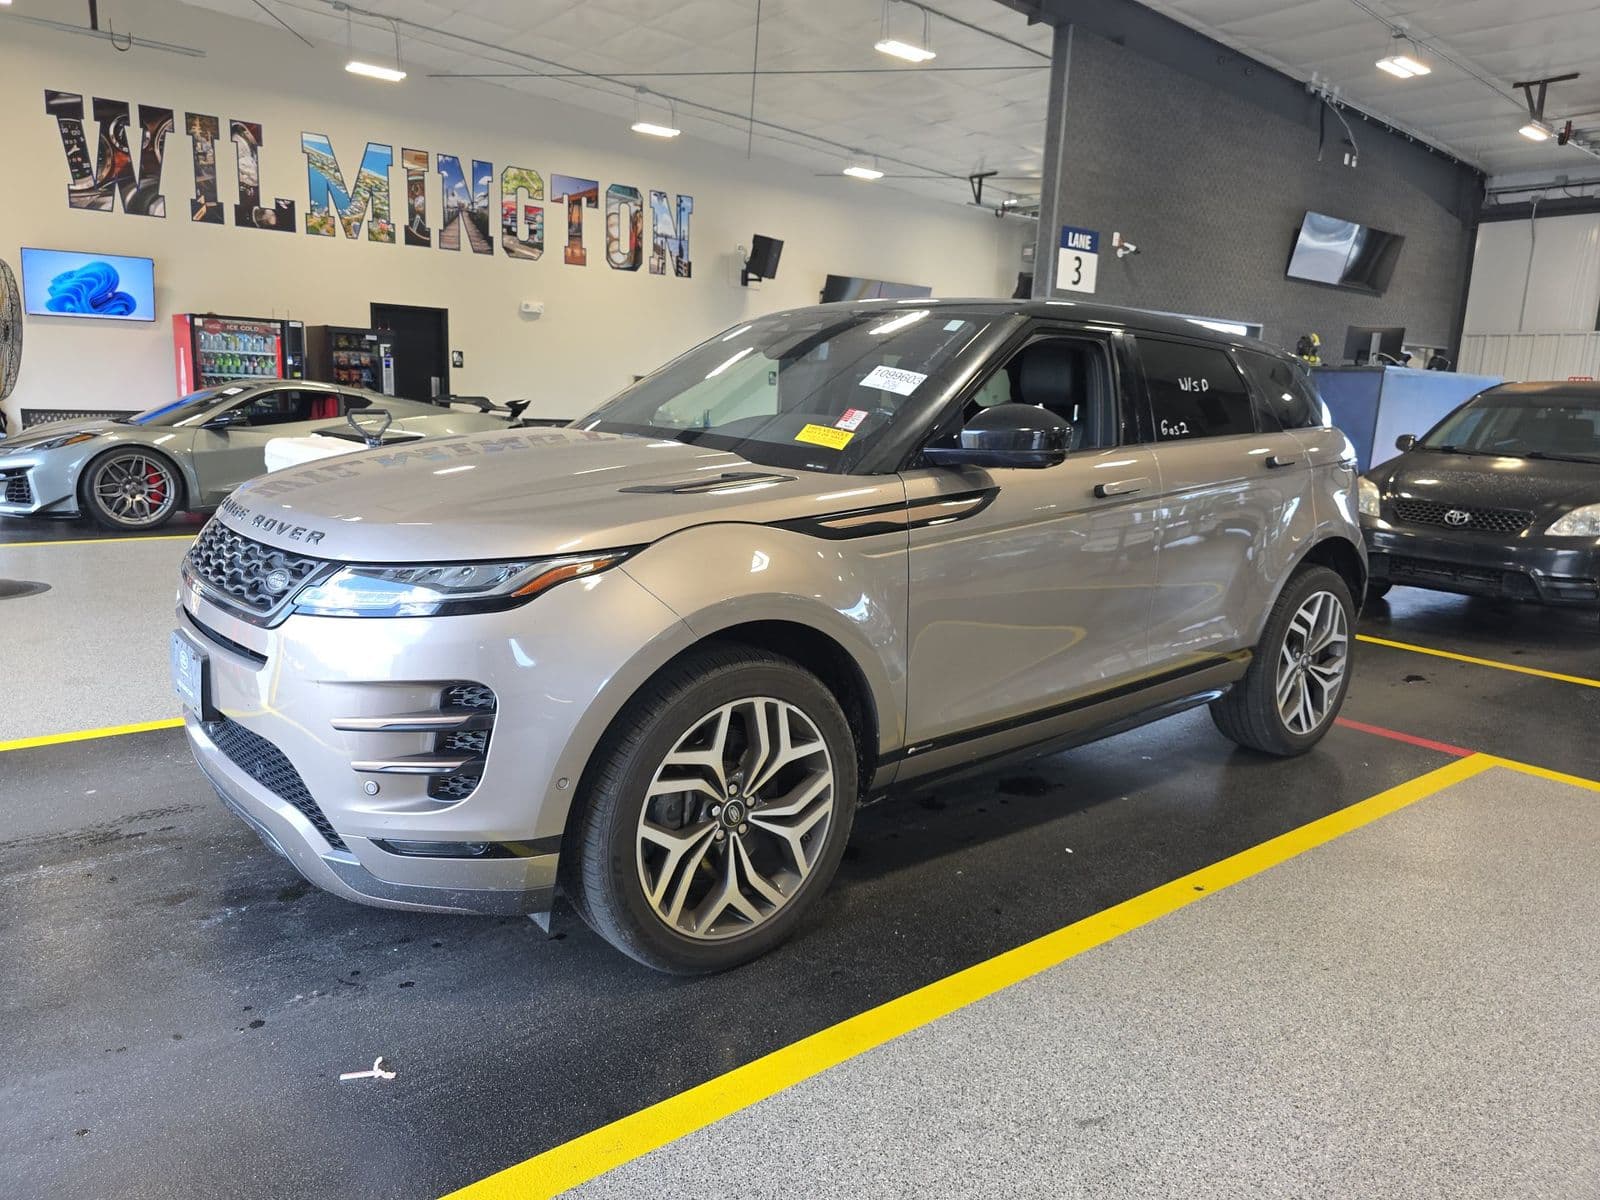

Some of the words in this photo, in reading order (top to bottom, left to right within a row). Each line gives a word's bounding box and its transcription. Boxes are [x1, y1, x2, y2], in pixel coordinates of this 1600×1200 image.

[44, 89, 693, 278] WILMINGTON
[1068, 231, 1092, 250] LANE
[1071, 255, 1082, 286] 3
[220, 495, 250, 520] ANGE
[251, 514, 326, 545] ROVER
